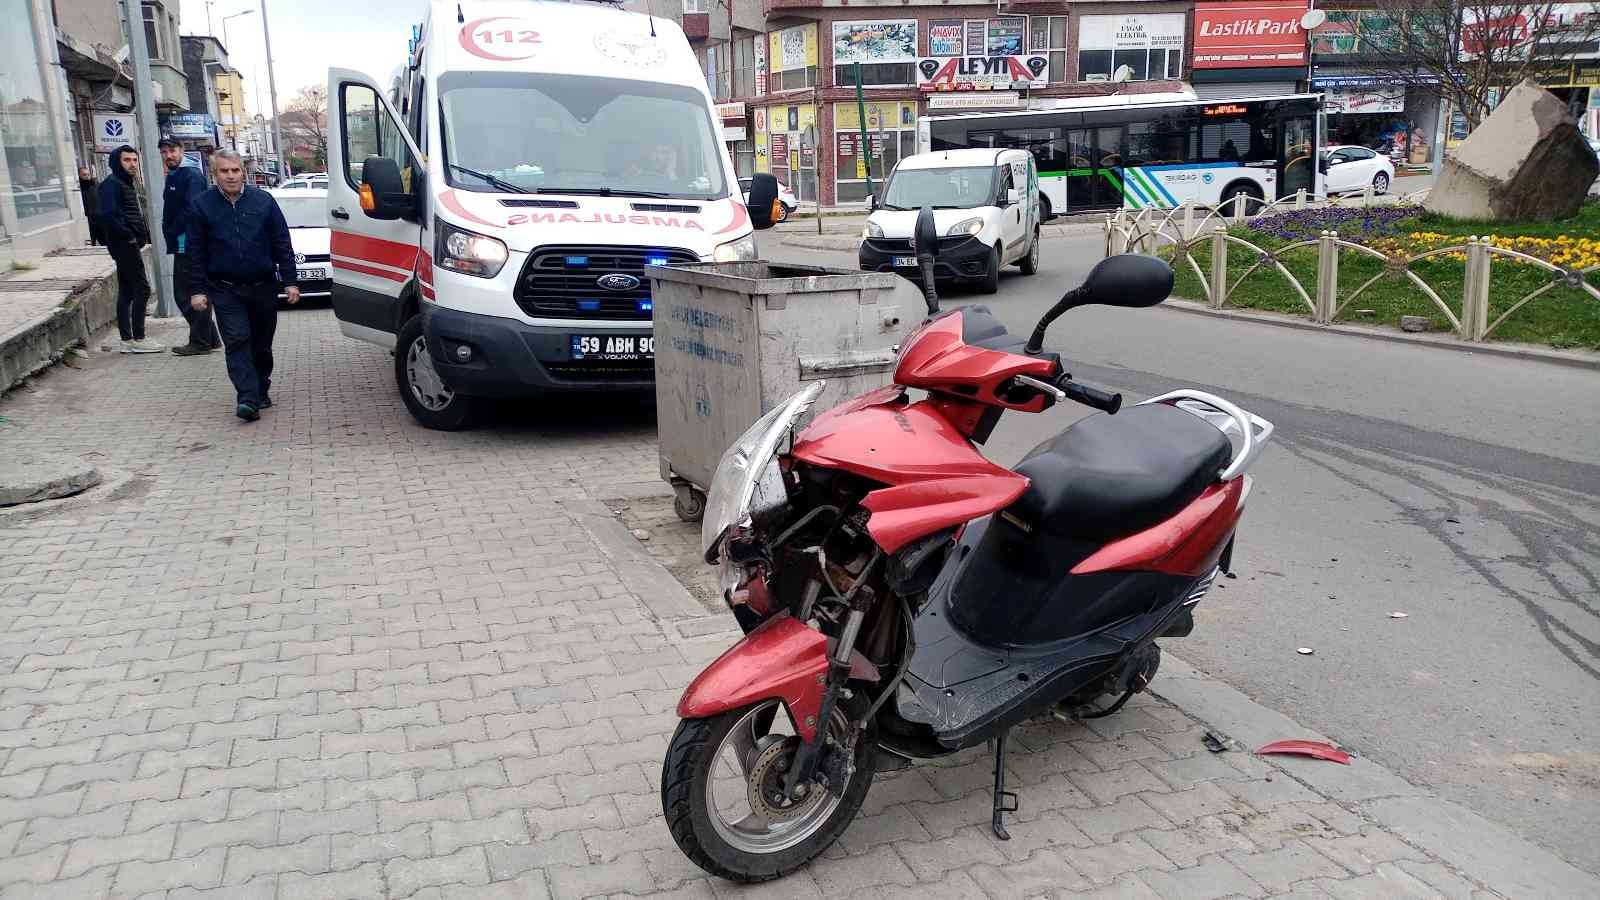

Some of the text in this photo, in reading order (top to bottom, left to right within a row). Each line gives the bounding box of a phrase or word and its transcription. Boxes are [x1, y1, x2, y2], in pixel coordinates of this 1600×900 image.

[1200, 18, 1300, 37] LastikPark
[475, 30, 542, 44] 112
[959, 82, 970, 90] JVC
[581, 336, 600, 353] 59
[605, 337, 635, 353] ABH
